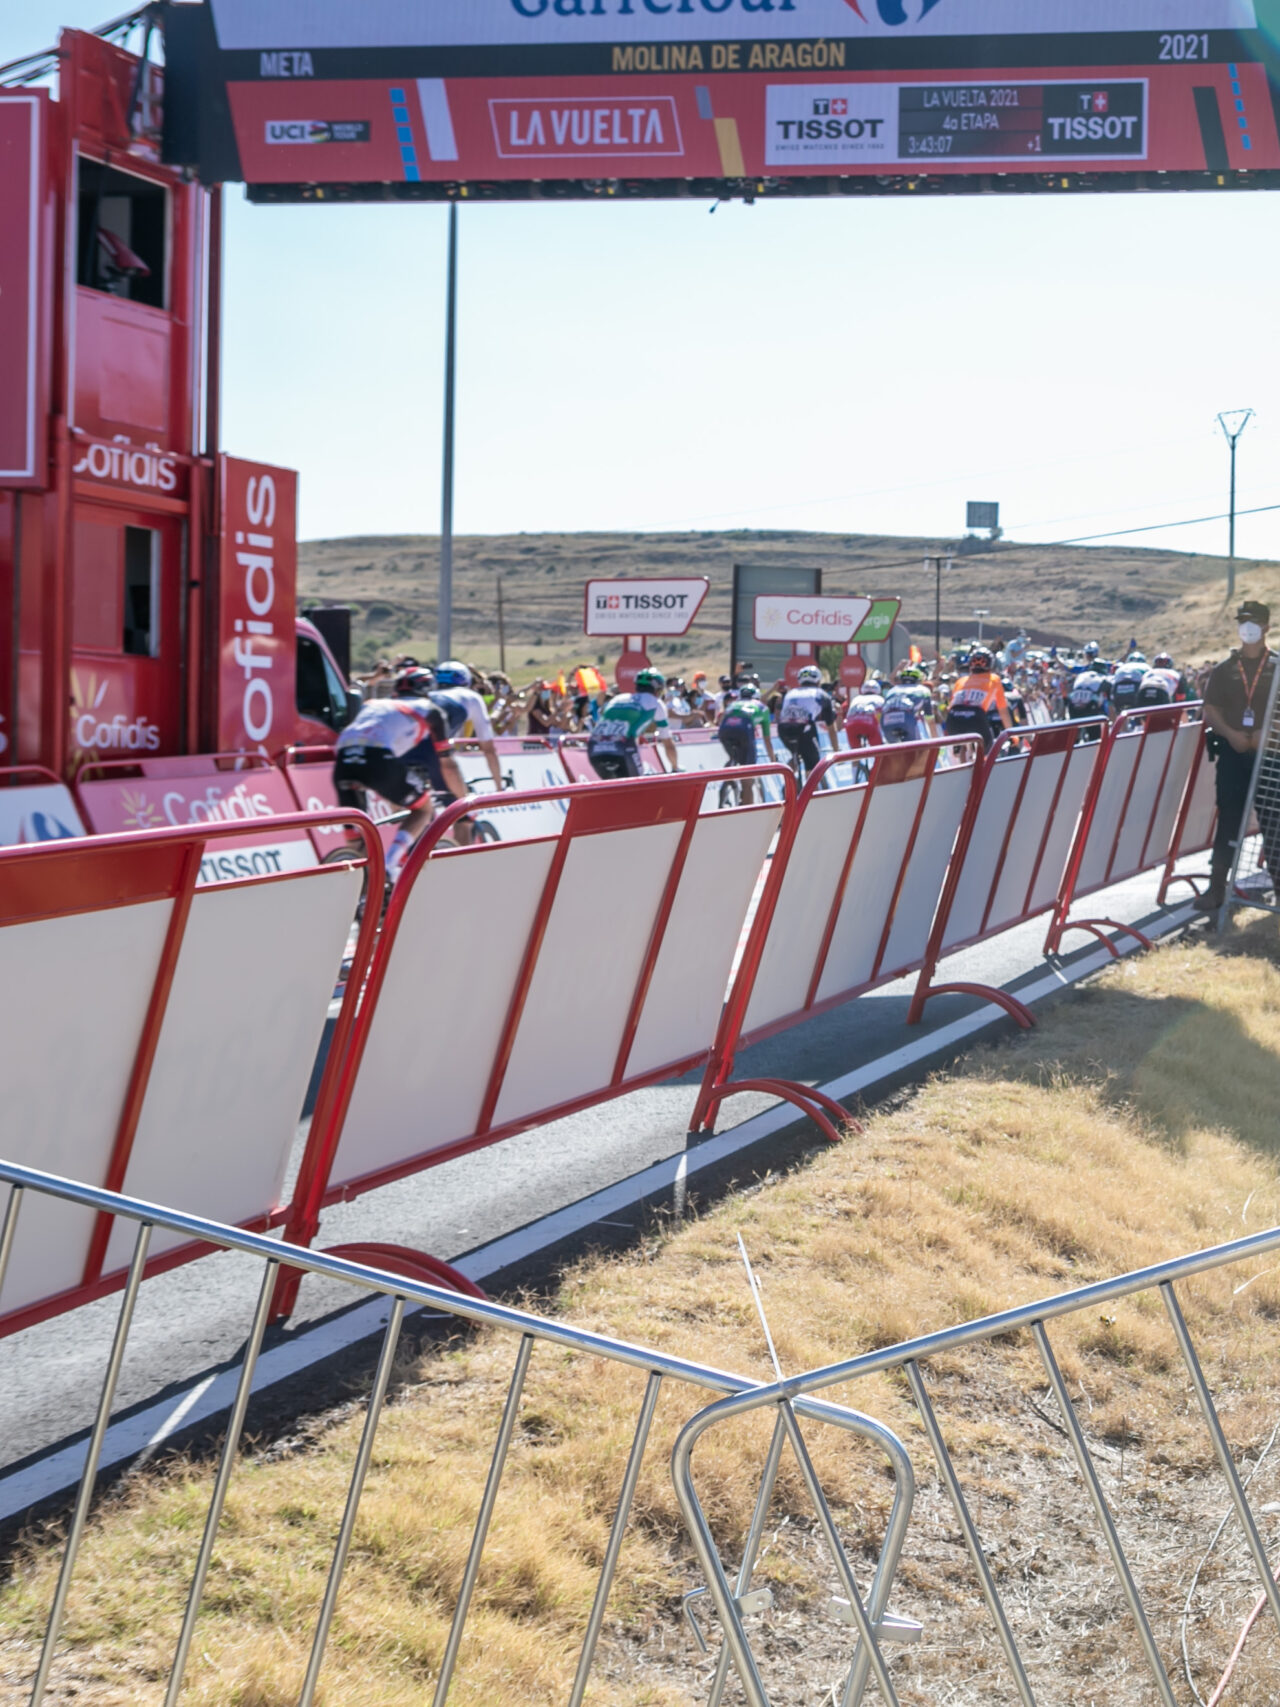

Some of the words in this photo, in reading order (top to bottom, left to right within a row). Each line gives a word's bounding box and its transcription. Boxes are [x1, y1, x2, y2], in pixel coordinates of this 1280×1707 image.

[611, 45, 704, 72] MOLINA
[711, 45, 740, 70] DE
[748, 38, 845, 69] ARAGÓN
[1158, 34, 1208, 60] 2021
[260, 52, 314, 77] META
[923, 91, 940, 108] LA
[942, 90, 987, 107] VUELTA
[990, 89, 1019, 106] 2021
[270, 125, 306, 139] UCI
[510, 110, 546, 146] LA
[550, 108, 664, 145] VUELTA
[776, 119, 884, 140] TISSOT
[961, 113, 999, 130] ETAPA
[1047, 116, 1138, 140] TISSOT
[908, 135, 953, 154] 3:43:07
[622, 594, 688, 610] TISSOT
[233, 474, 277, 770] ofidis
[786, 608, 853, 627] Cofidis
[75, 714, 160, 750] Cofidis
